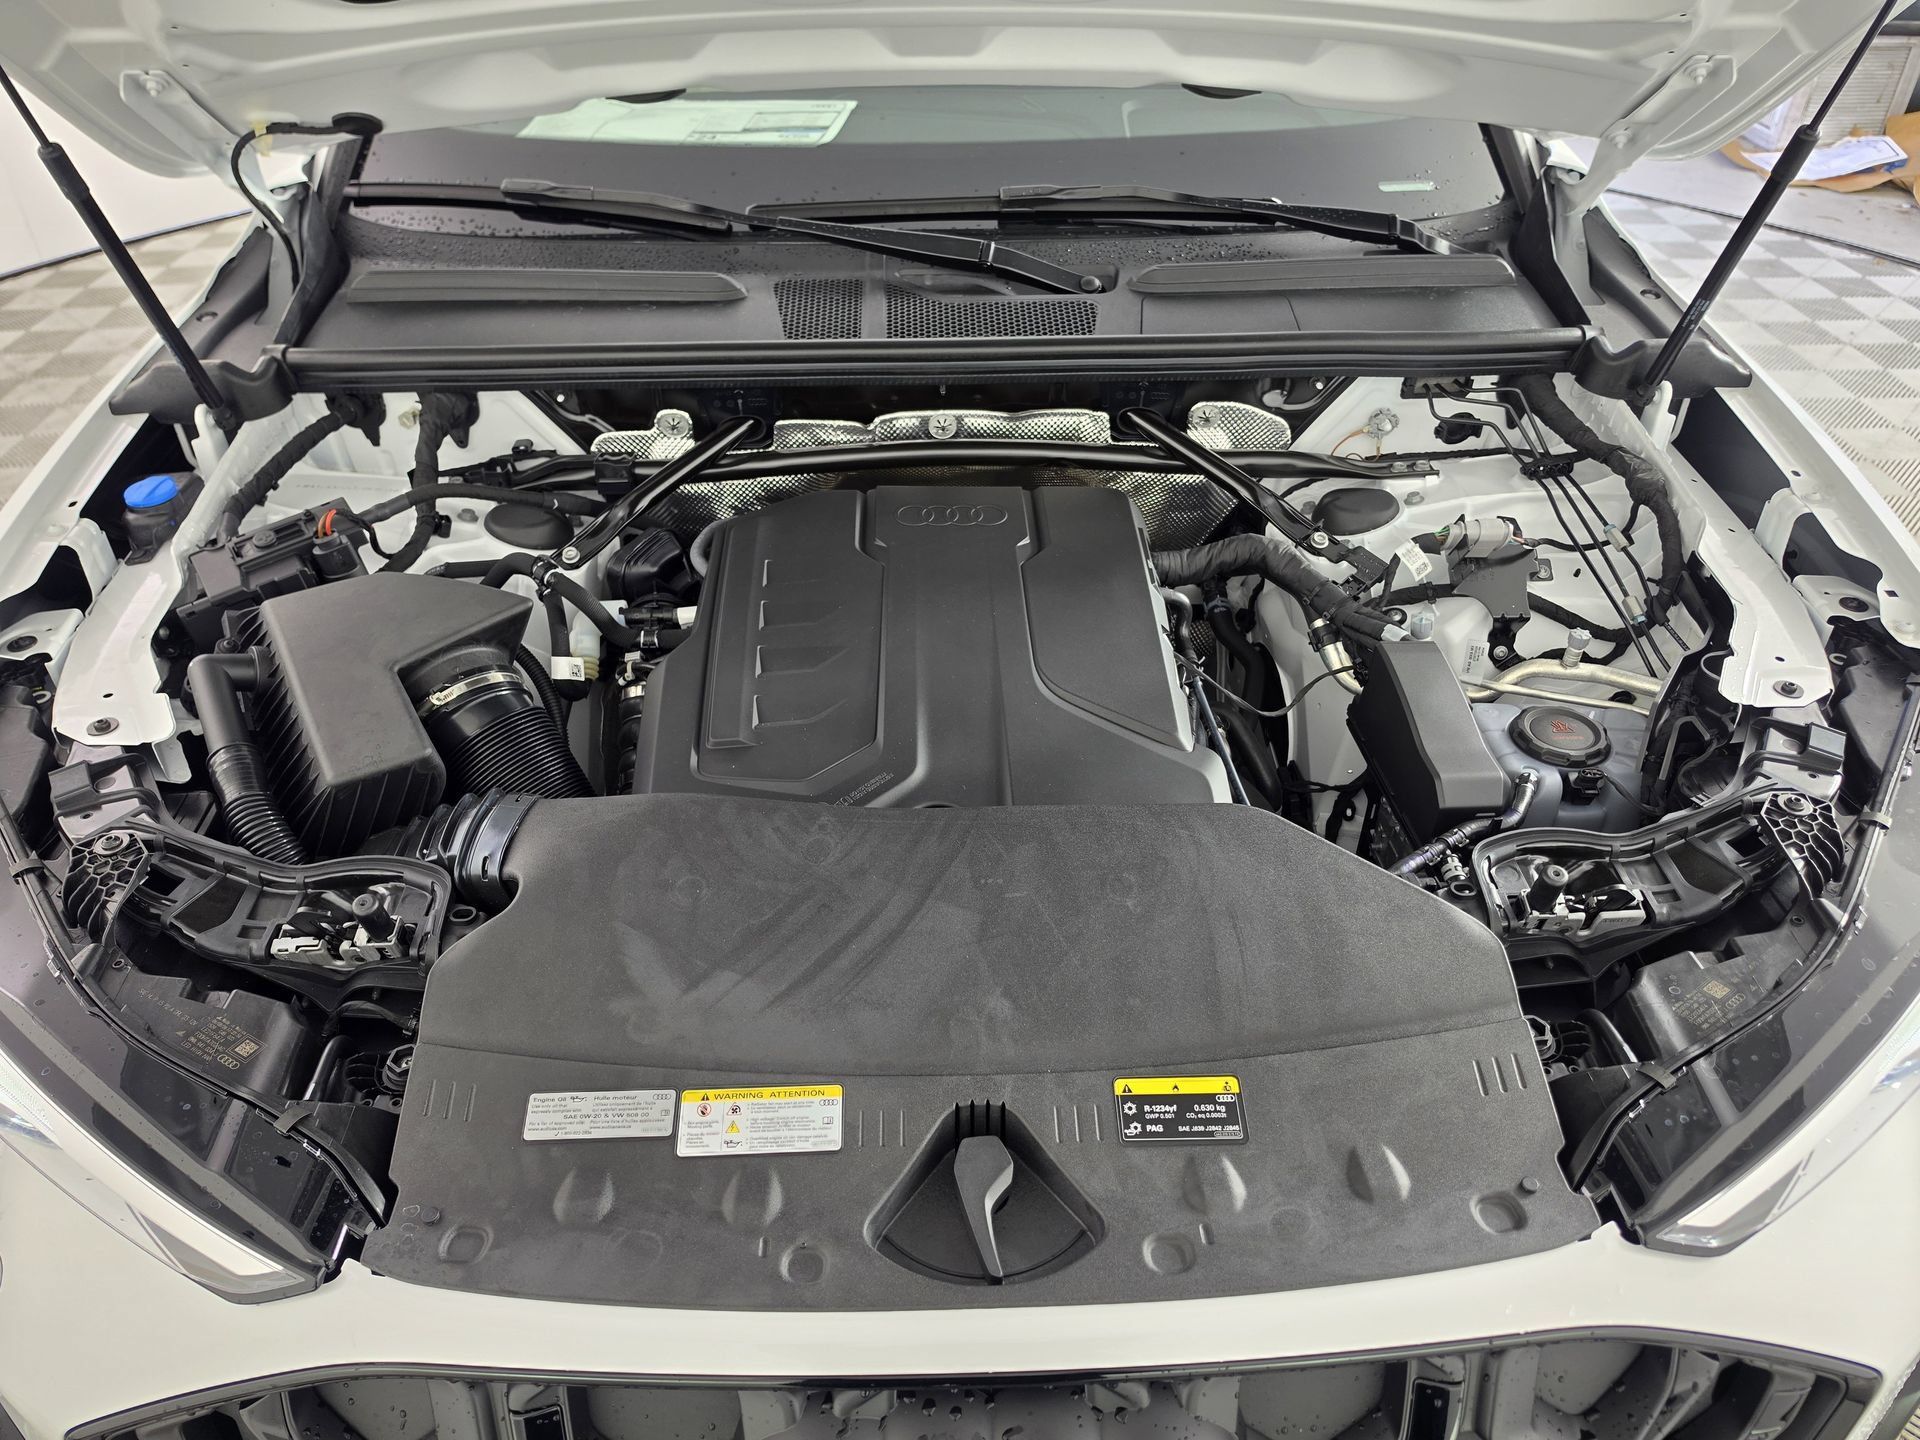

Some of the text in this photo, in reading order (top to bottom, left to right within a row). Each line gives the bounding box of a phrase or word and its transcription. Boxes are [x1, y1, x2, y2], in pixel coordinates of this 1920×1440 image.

[713, 1090, 825, 1100] WARNING ATTENTION
[1143, 1104, 1177, 1114] R-1234yf
[1215, 1103, 1226, 1113] kg
[1146, 1124, 1164, 1132] PAG
